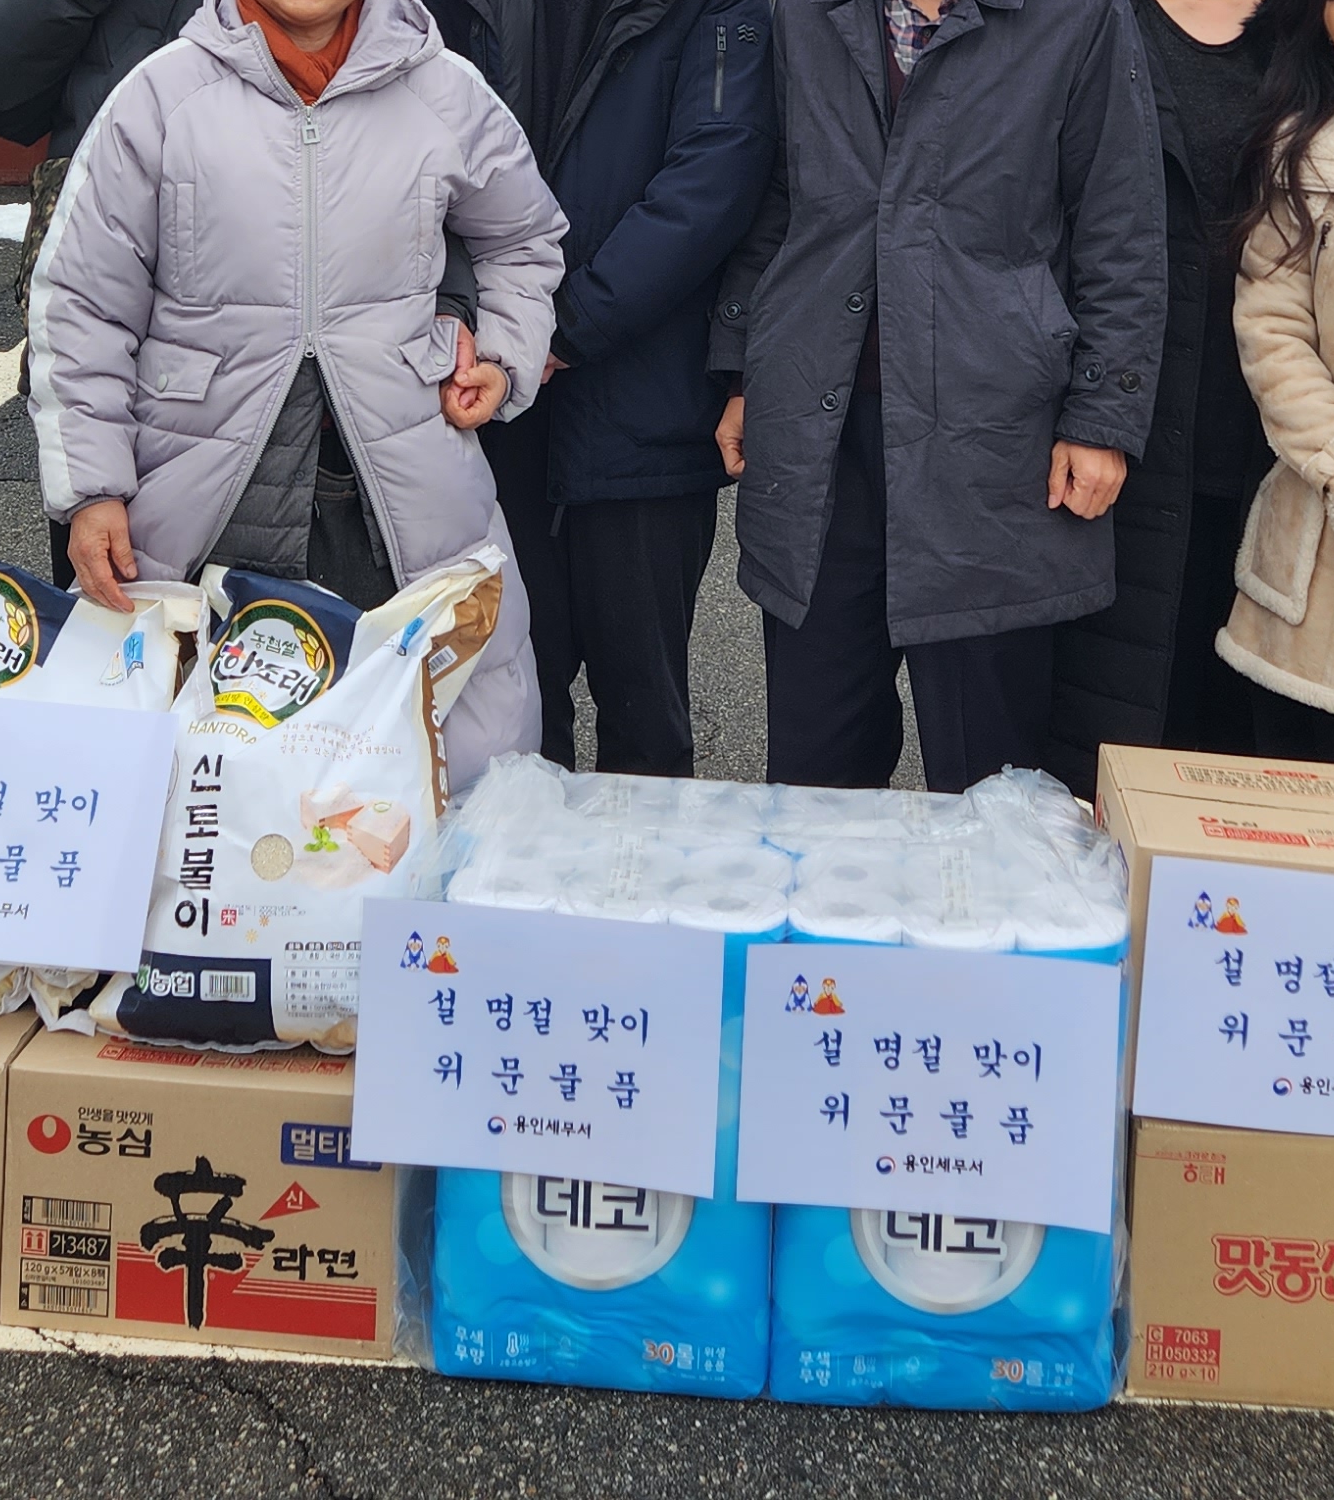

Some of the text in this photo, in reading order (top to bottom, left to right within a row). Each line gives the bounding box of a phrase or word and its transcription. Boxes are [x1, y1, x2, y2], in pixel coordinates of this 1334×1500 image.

[250, 630, 300, 659] 농협쌀
[213, 641, 318, 703] 한토래
[35, 785, 99, 826] 맞이
[173, 754, 224, 938] 신토불이
[221, 909, 237, 926] 米
[1216, 947, 1244, 987] 설
[150, 968, 195, 997] 농협
[427, 987, 649, 1048] 설 명절 맞이
[813, 1027, 1042, 1082] 설 명절 맞이
[78, 1106, 154, 1127] 인생을 맛있게
[513, 1114, 592, 1140] 용인세무서
[76, 1122, 153, 1159] 농심
[290, 1128, 352, 1164] 멀티
[902, 1153, 984, 1177] 용인세무서
[285, 1190, 304, 1210] 신
[536, 1174, 650, 1233] 데코
[51, 1233, 109, 1257] 가3487
[139, 1154, 276, 1331] 辛
[24, 1261, 43, 1273] 120
[271, 1243, 359, 1281] 라면
[455, 1325, 484, 1347] 무색
[1174, 1328, 1209, 1346] 7063
[455, 1343, 484, 1366] 무향
[1165, 1346, 1217, 1364] 050332
[1148, 1363, 1174, 1379] 210
